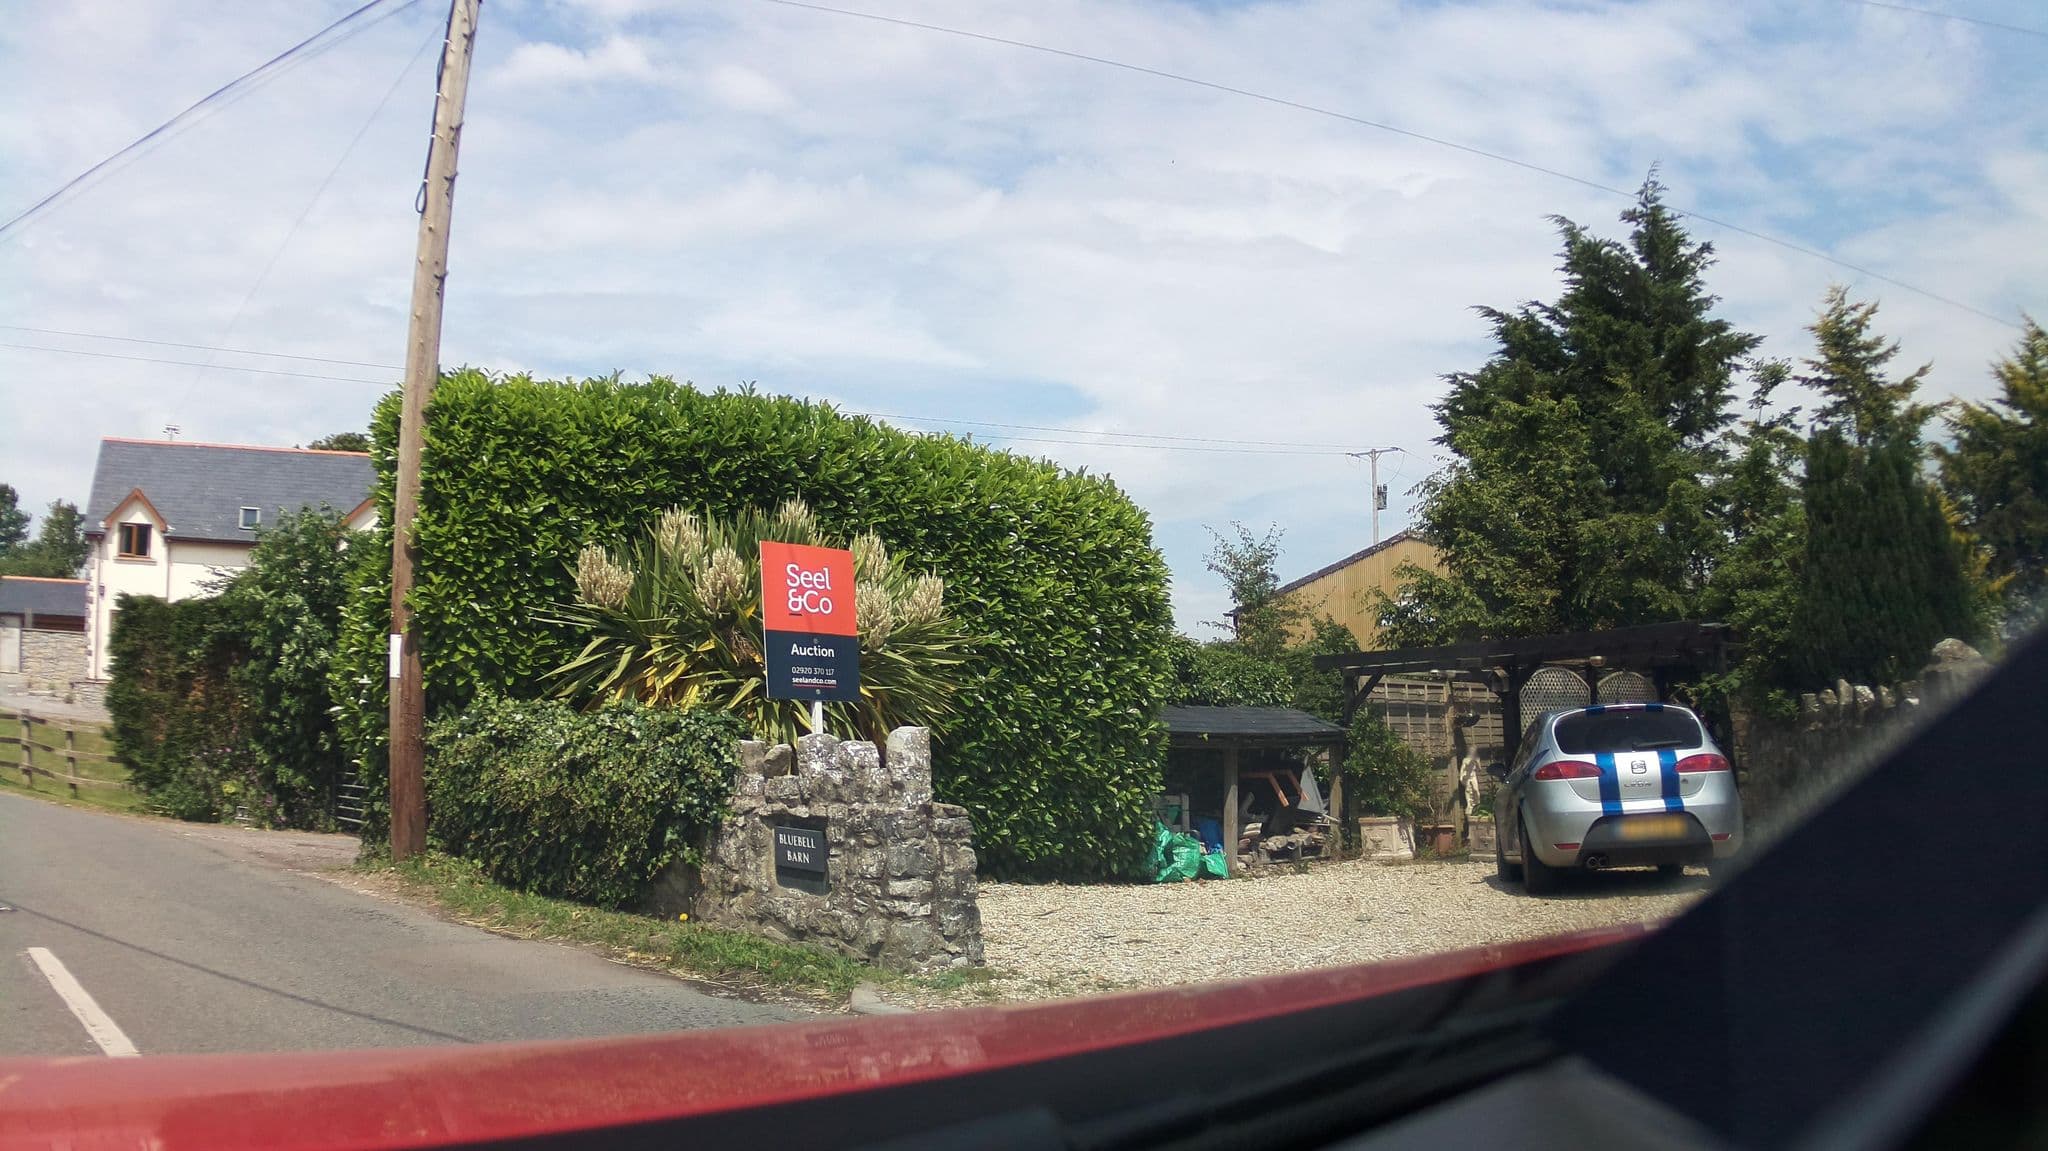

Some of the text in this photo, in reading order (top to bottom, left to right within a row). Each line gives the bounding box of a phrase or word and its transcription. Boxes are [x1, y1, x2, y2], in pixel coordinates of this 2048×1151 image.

[786, 563, 831, 590] Seel
[788, 588, 833, 614] &Co
[791, 643, 835, 658] Auction
[791, 666, 835, 676] 02920 370 117
[792, 676, 837, 685] seelandco.com
[779, 833, 816, 849] BLUEBELL
[787, 850, 810, 864] BARN
